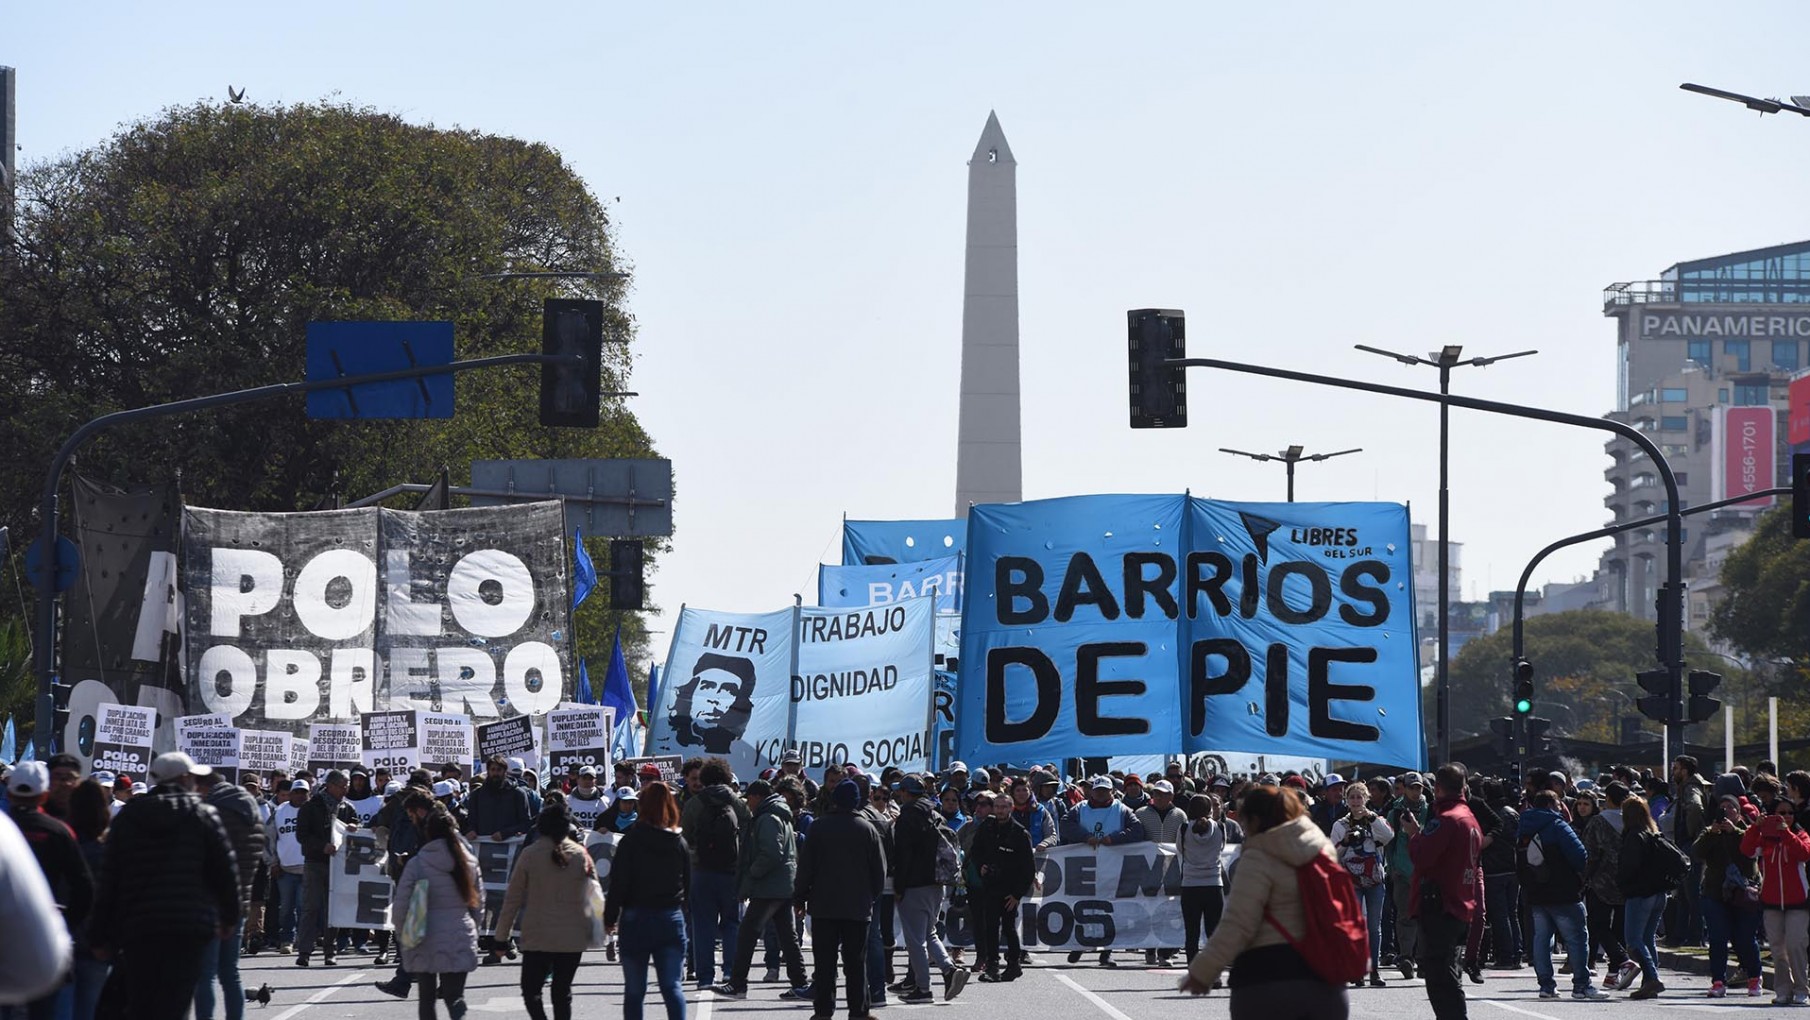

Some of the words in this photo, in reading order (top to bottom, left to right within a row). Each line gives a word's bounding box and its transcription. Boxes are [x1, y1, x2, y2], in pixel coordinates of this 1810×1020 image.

[1643, 314, 1810, 337] PANAMERIC
[1743, 421, 1756, 492] 4556-1701
[1291, 528, 1358, 546] LIBRES
[1324, 549, 1346, 558] DEL
[1349, 547, 1372, 558] SUR
[210, 548, 535, 640] POLO
[995, 551, 1391, 627] BARRIOS
[800, 607, 905, 643] TRABAJO
[703, 623, 767, 654] MTR
[199, 641, 563, 720] OBRERO
[790, 664, 897, 702] DIGNIDAD
[984, 641, 1151, 744] DE
[1188, 638, 1380, 742] PIE
[139, 720, 147, 729] DE
[183, 718, 212, 727] SEGURO
[214, 717, 223, 725] AL
[556, 721, 596, 731] INMEDIATA
[100, 725, 112, 733] LOS
[318, 729, 347, 737] SEGURO
[109, 734, 138, 744] SOCIALES
[313, 737, 360, 746] DESOCUPADO
[551, 732, 558, 741] DE
[559, 732, 569, 741] LOS
[275, 745, 283, 753] DE
[423, 746, 433, 754] LOS
[434, 746, 469, 755] PROGRAMAS
[755, 739, 768, 767] Y
[768, 738, 848, 768] CAMBIO
[861, 730, 931, 768] SOCIAL
[103, 750, 139, 762] POLO
[239, 752, 250, 760] LOS
[335, 752, 360, 760] FAMILIAR
[93, 760, 147, 773] OBRERO
[248, 761, 276, 769] SOCIALES
[374, 757, 407, 767] POLO
